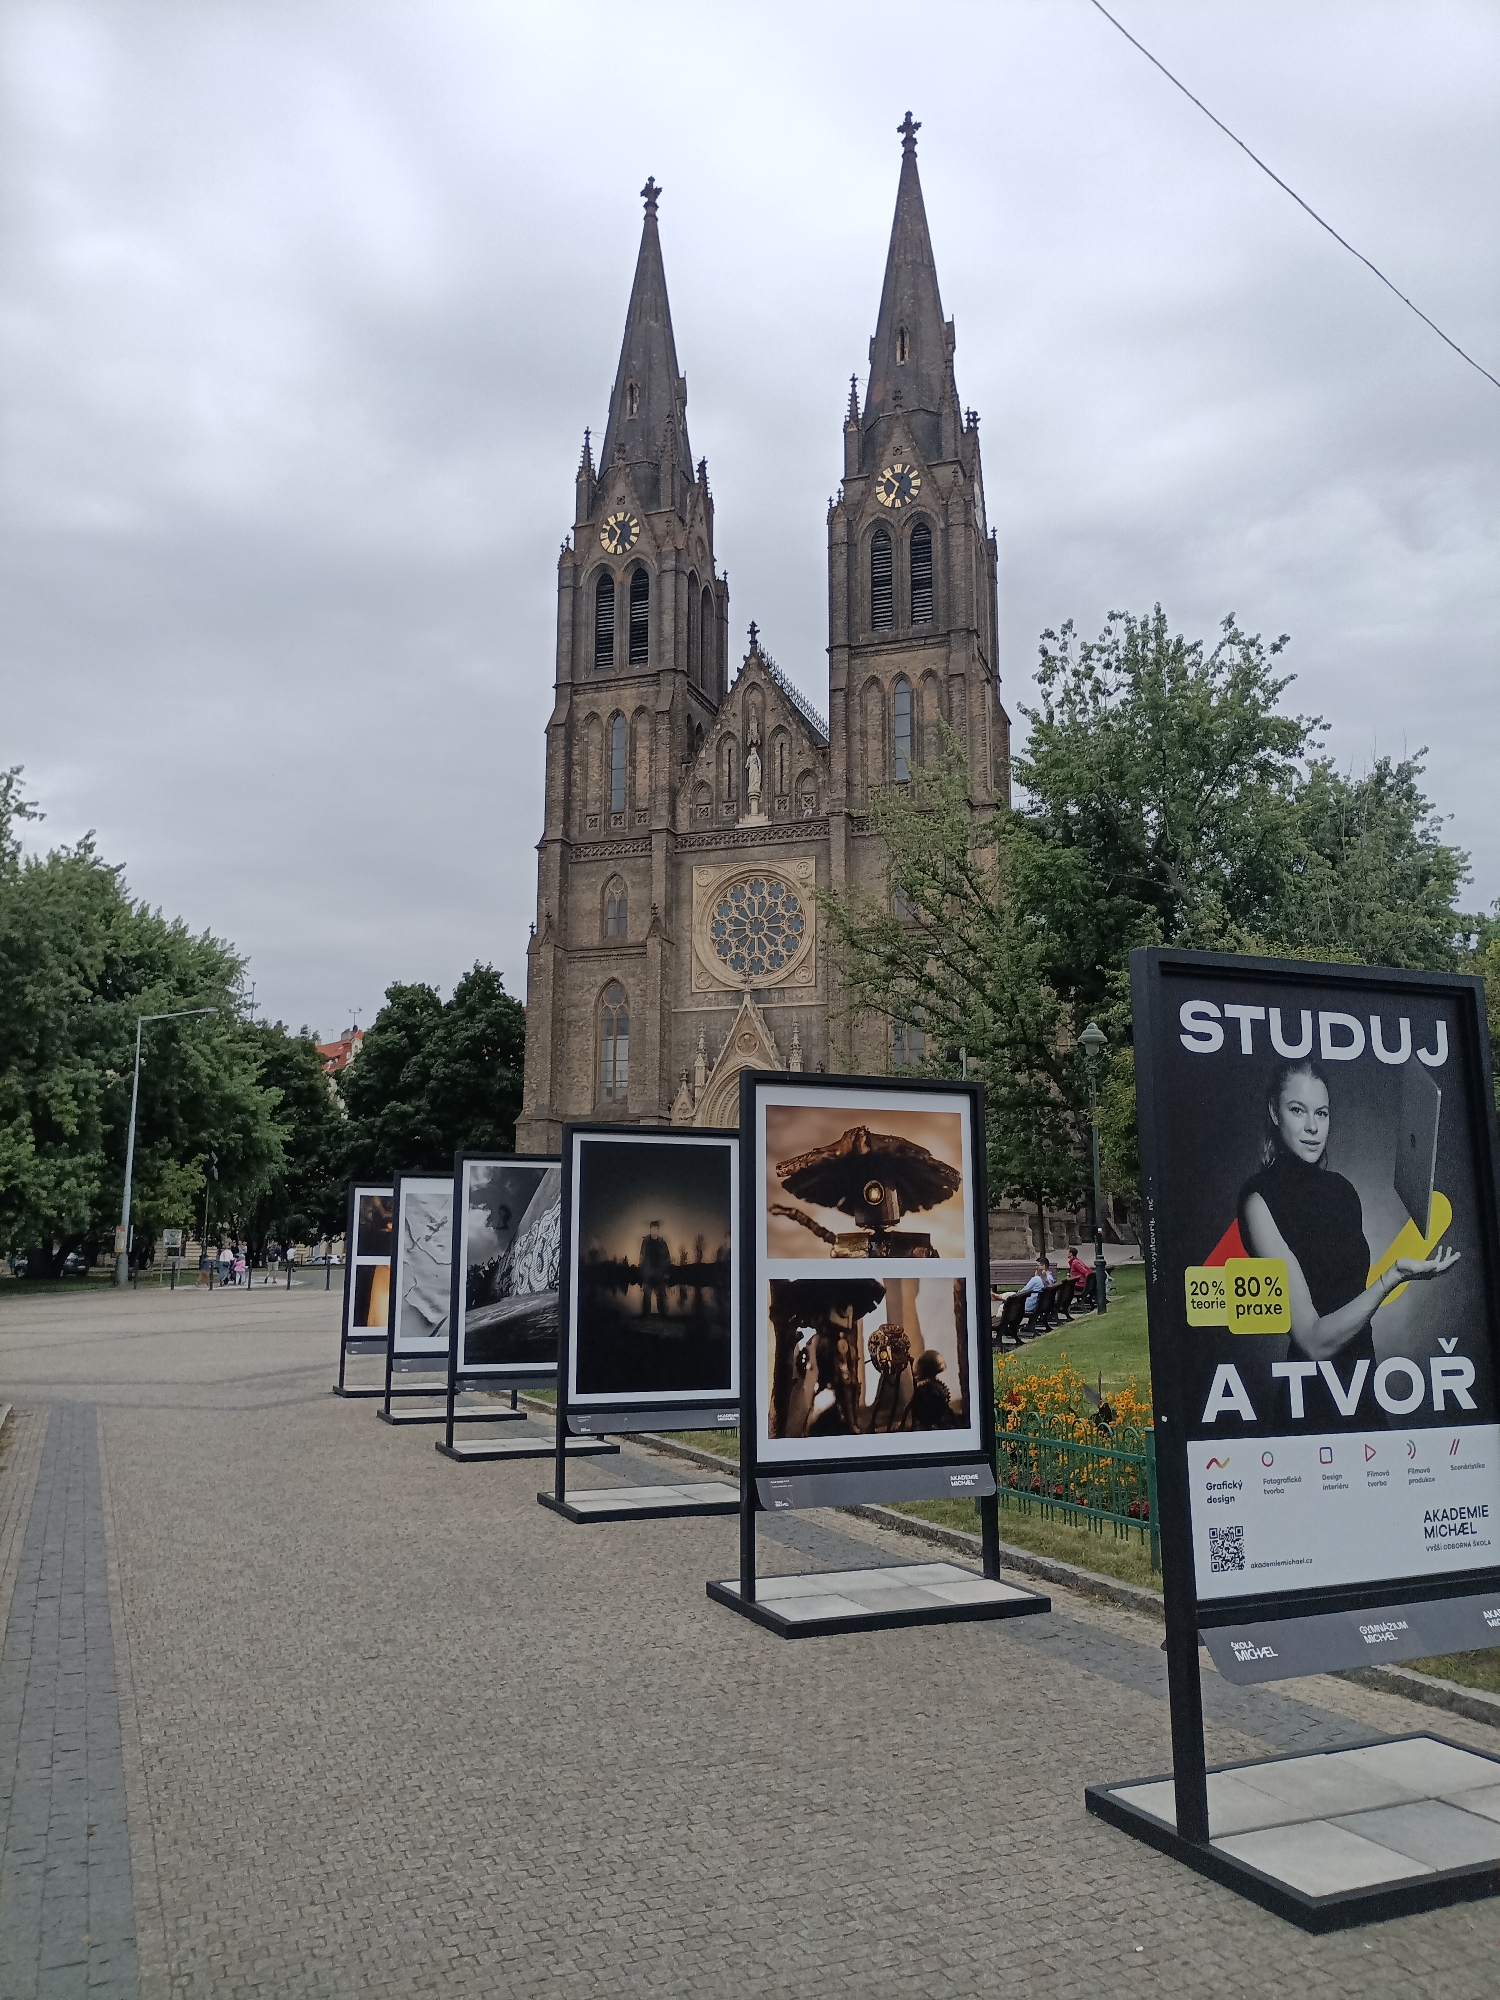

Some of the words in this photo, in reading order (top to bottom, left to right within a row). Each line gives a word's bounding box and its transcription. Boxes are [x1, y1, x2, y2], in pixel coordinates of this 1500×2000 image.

[1179, 1000, 1449, 1067] STUDUJ
[1190, 1297, 1226, 1310] teorie
[1235, 1303, 1283, 1319] praxe
[1201, 1363, 1257, 1423] A
[1271, 1337, 1478, 1419] TVOŘ
[1262, 1475, 1302, 1486] Fotografická
[1321, 1473, 1343, 1482] Design
[1408, 1477, 1436, 1486] produkce
[1205, 1479, 1243, 1491] Grafický
[1322, 1483, 1349, 1491] interiéru
[1263, 1487, 1285, 1495] tvorba
[1206, 1494, 1236, 1505] design
[1423, 1504, 1490, 1523] AKADEMIE
[1472, 1539, 1492, 1548] ŠKOLA
[1250, 1557, 1313, 1570] akademiemichael.cz
[1359, 1620, 1409, 1635] GYMNÁZIUM
[1230, 1640, 1255, 1651] ŠKOLA
